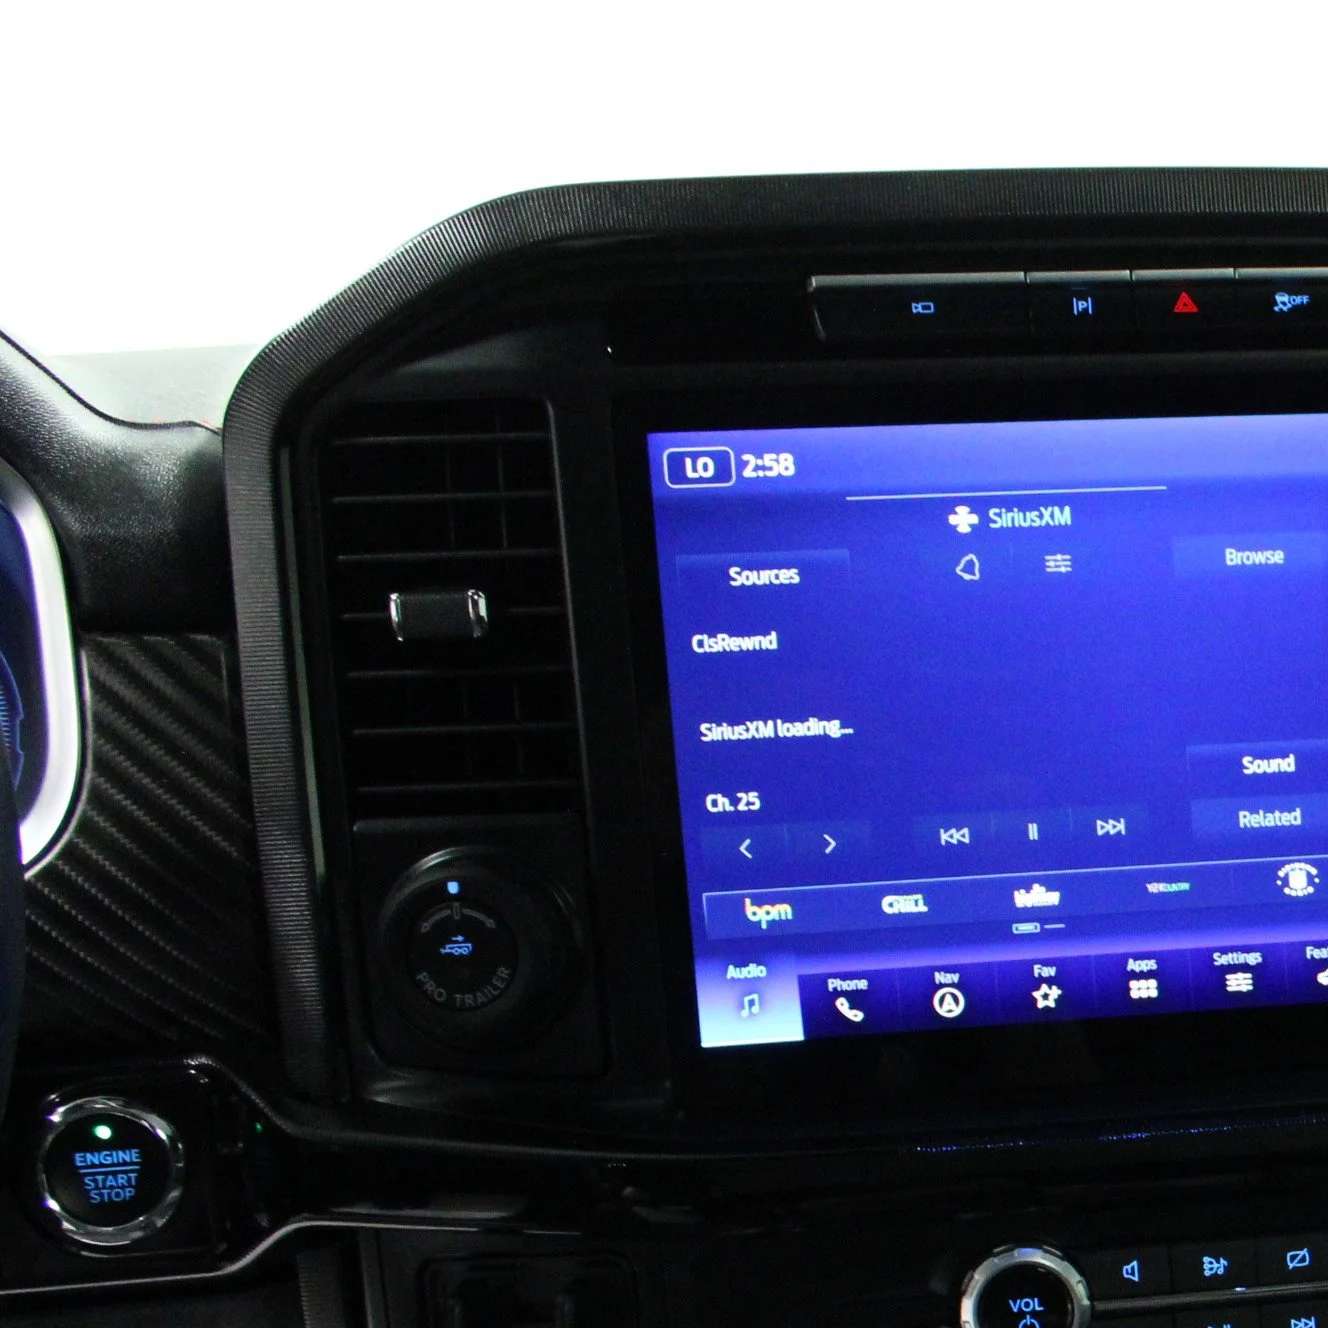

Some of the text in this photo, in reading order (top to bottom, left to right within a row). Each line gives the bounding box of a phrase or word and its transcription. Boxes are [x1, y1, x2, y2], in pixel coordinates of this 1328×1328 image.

[1290, 295, 1310, 306] OFF
[684, 456, 714, 479] LO
[741, 453, 795, 478] 2:58
[988, 505, 1072, 528] SiriusXM
[1225, 547, 1285, 566] Browse
[729, 566, 800, 587] Sources
[691, 631, 778, 654] ClsRewnd
[700, 720, 775, 742] SiriusXM
[1242, 754, 1296, 775] Sound
[705, 792, 760, 812] Ch. 25
[1238, 808, 1302, 829] Related
[744, 898, 793, 929] bpm
[1127, 957, 1158, 974] Apps
[1213, 950, 1262, 968] Settings
[727, 963, 767, 979] Audio
[934, 971, 960, 985] Nav
[1033, 964, 1057, 978] Fav
[416, 966, 511, 1008] PRO TRAILER
[827, 976, 868, 992] Phone
[74, 1149, 142, 1166] ENGINE
[84, 1173, 138, 1189] START
[90, 1188, 136, 1203] STOP
[1009, 1298, 1044, 1312] VOL
